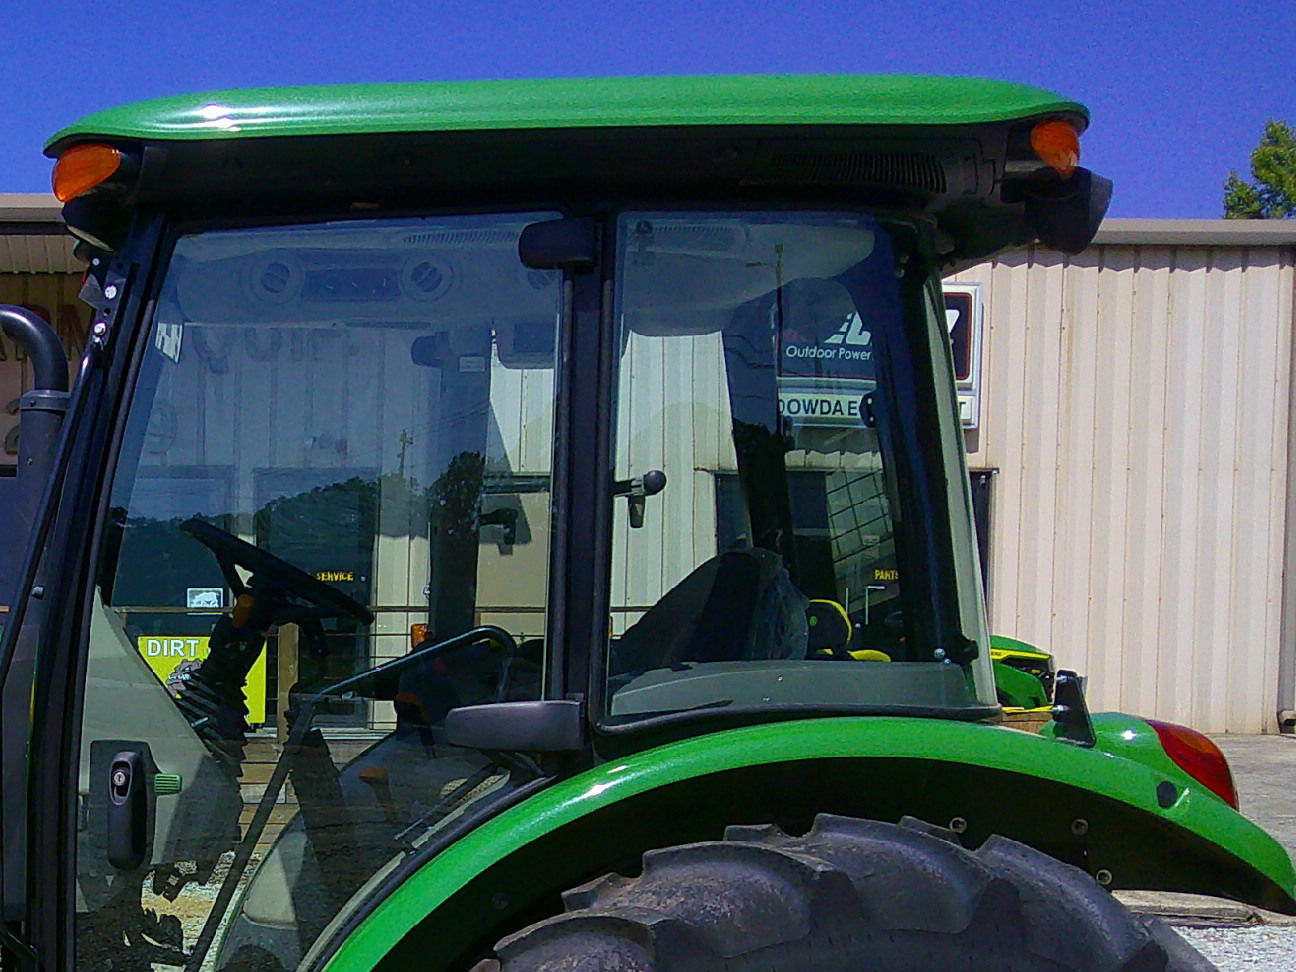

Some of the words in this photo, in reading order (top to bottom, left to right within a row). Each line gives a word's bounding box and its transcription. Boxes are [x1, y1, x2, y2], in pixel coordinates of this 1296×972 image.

[785, 345, 836, 358] Outdoor
[838, 346, 872, 360] Power
[316, 571, 354, 582] SERVICE
[147, 639, 200, 657] DIRT
